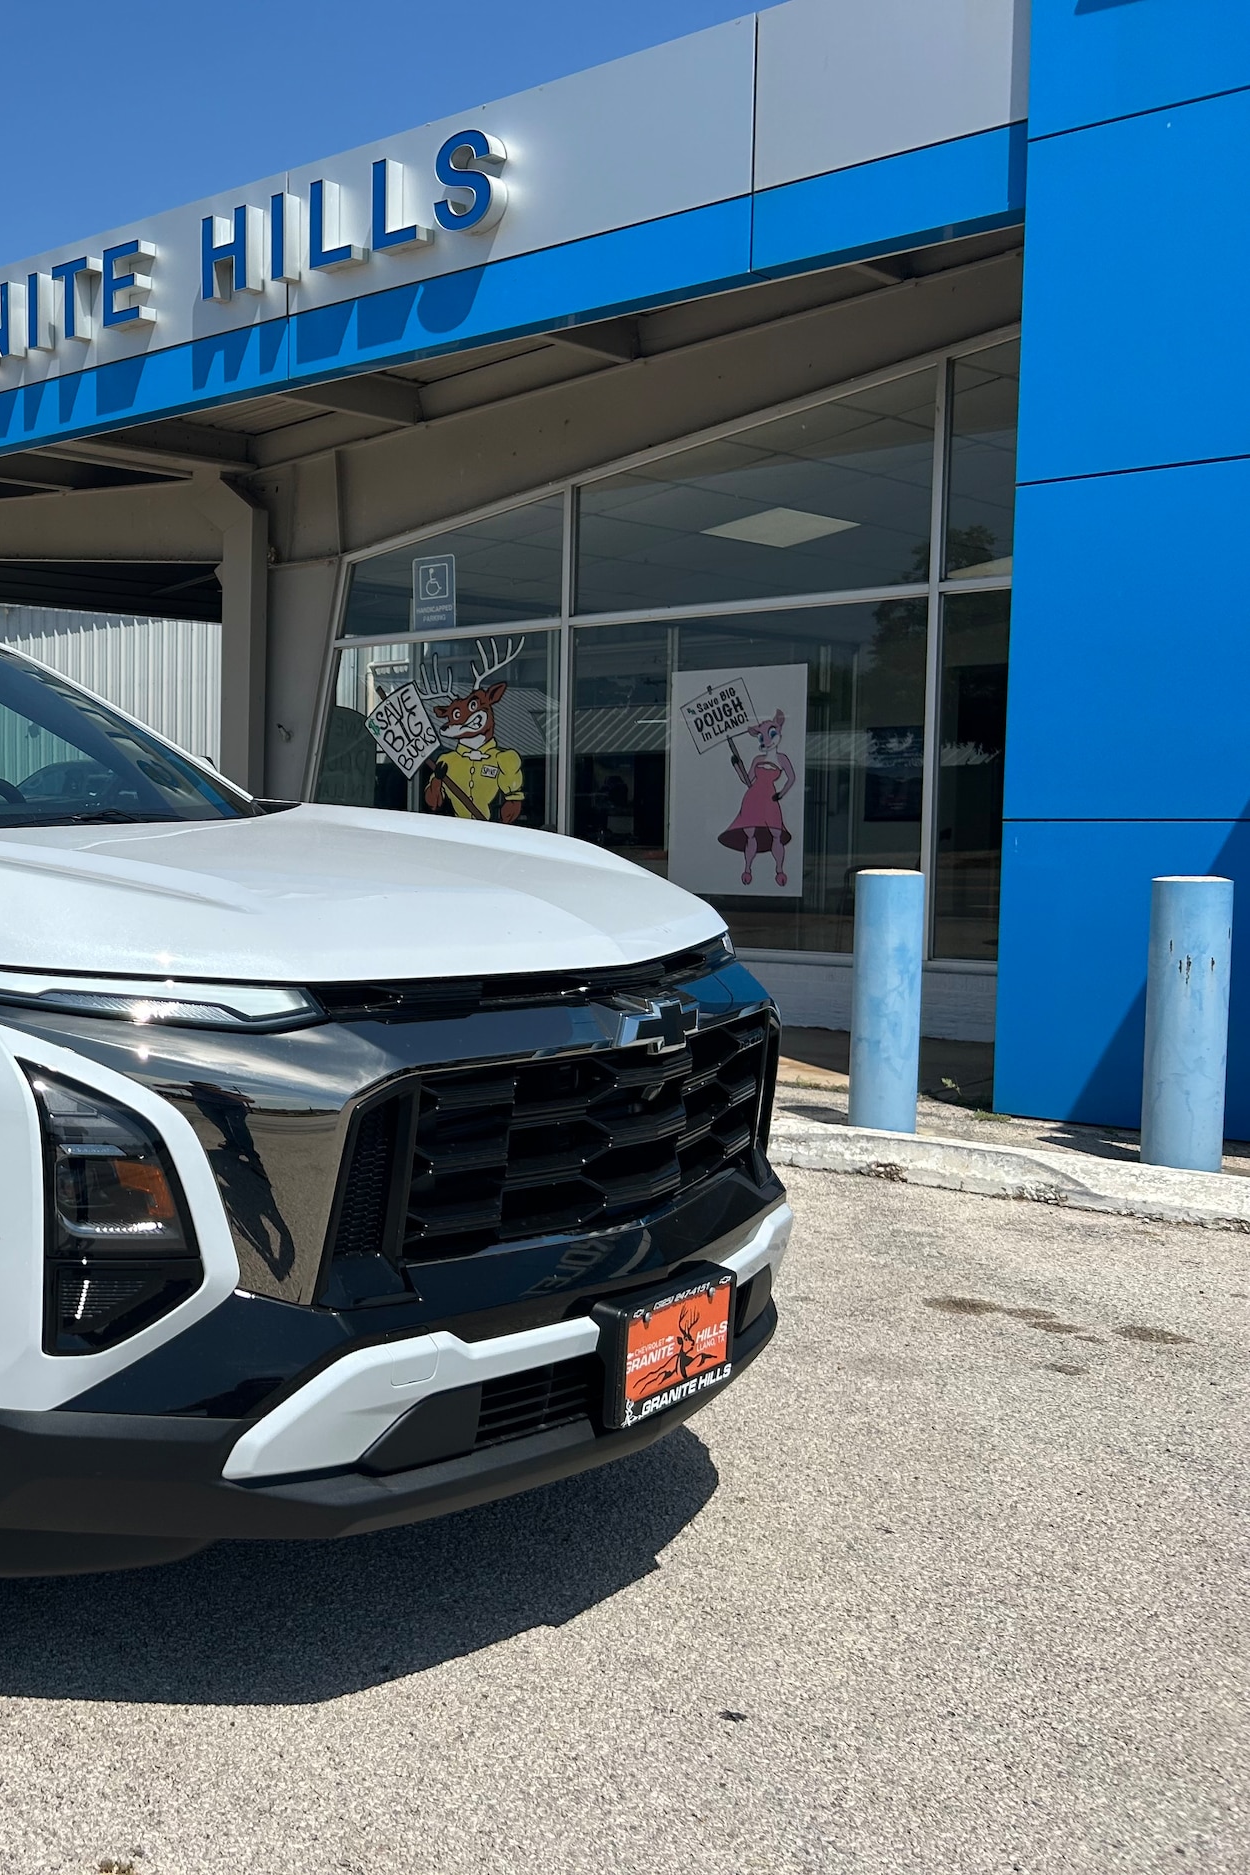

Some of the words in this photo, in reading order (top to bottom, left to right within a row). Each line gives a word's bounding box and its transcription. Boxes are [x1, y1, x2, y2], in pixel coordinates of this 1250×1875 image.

[200, 128, 507, 303] HILLS
[416, 604, 453, 614] HANDICAPPED
[422, 614, 447, 622] PARKING
[376, 688, 417, 730] SAVE
[693, 696, 745, 733] DOUGH
[696, 697, 719, 713] Save
[719, 687, 736, 702] BIG
[383, 711, 423, 752] BIG
[712, 711, 749, 737] LLANO!
[397, 727, 437, 771] BUCKS
[695, 1320, 729, 1343] HILLS
[717, 1335, 725, 1344] TX
[626, 1342, 675, 1375] GRANITE
[634, 1337, 665, 1357] CHEVROLET
[641, 1377, 698, 1416] GRANITE
[697, 1363, 732, 1391] HILLS
